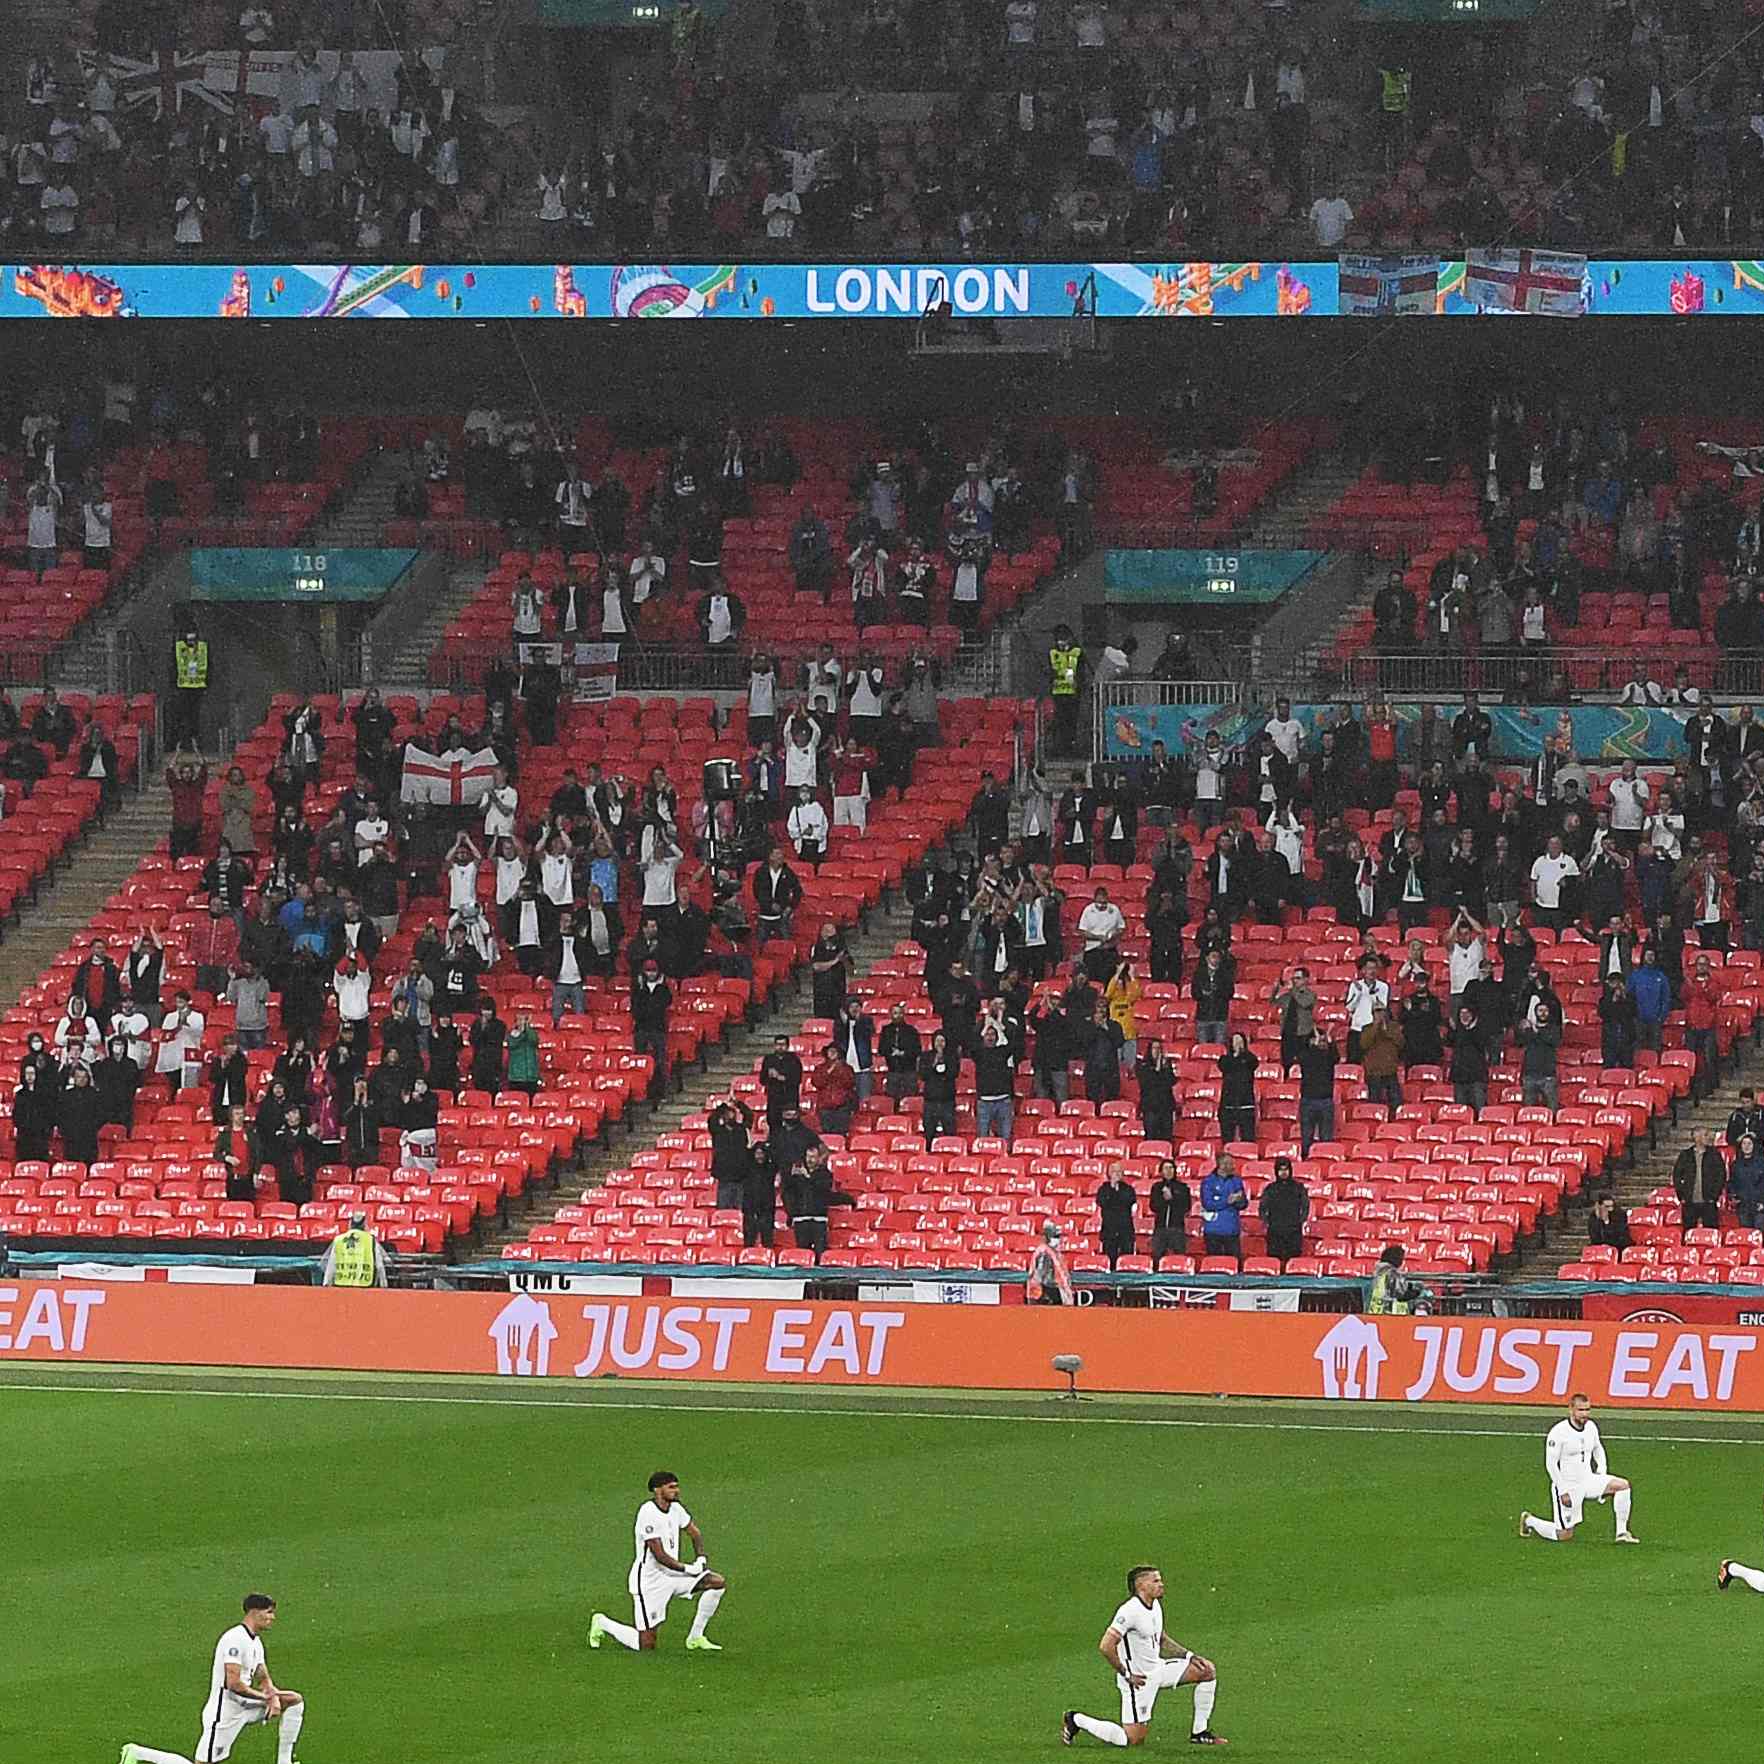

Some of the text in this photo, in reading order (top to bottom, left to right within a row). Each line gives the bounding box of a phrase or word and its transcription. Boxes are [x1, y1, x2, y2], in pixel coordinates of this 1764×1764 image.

[806, 268, 1029, 312] LONDON
[293, 555, 327, 572] 118
[1205, 557, 1239, 573] 119
[574, 1304, 905, 1377] JUST EAT
[1405, 1326, 1758, 1401] JUST EAT
